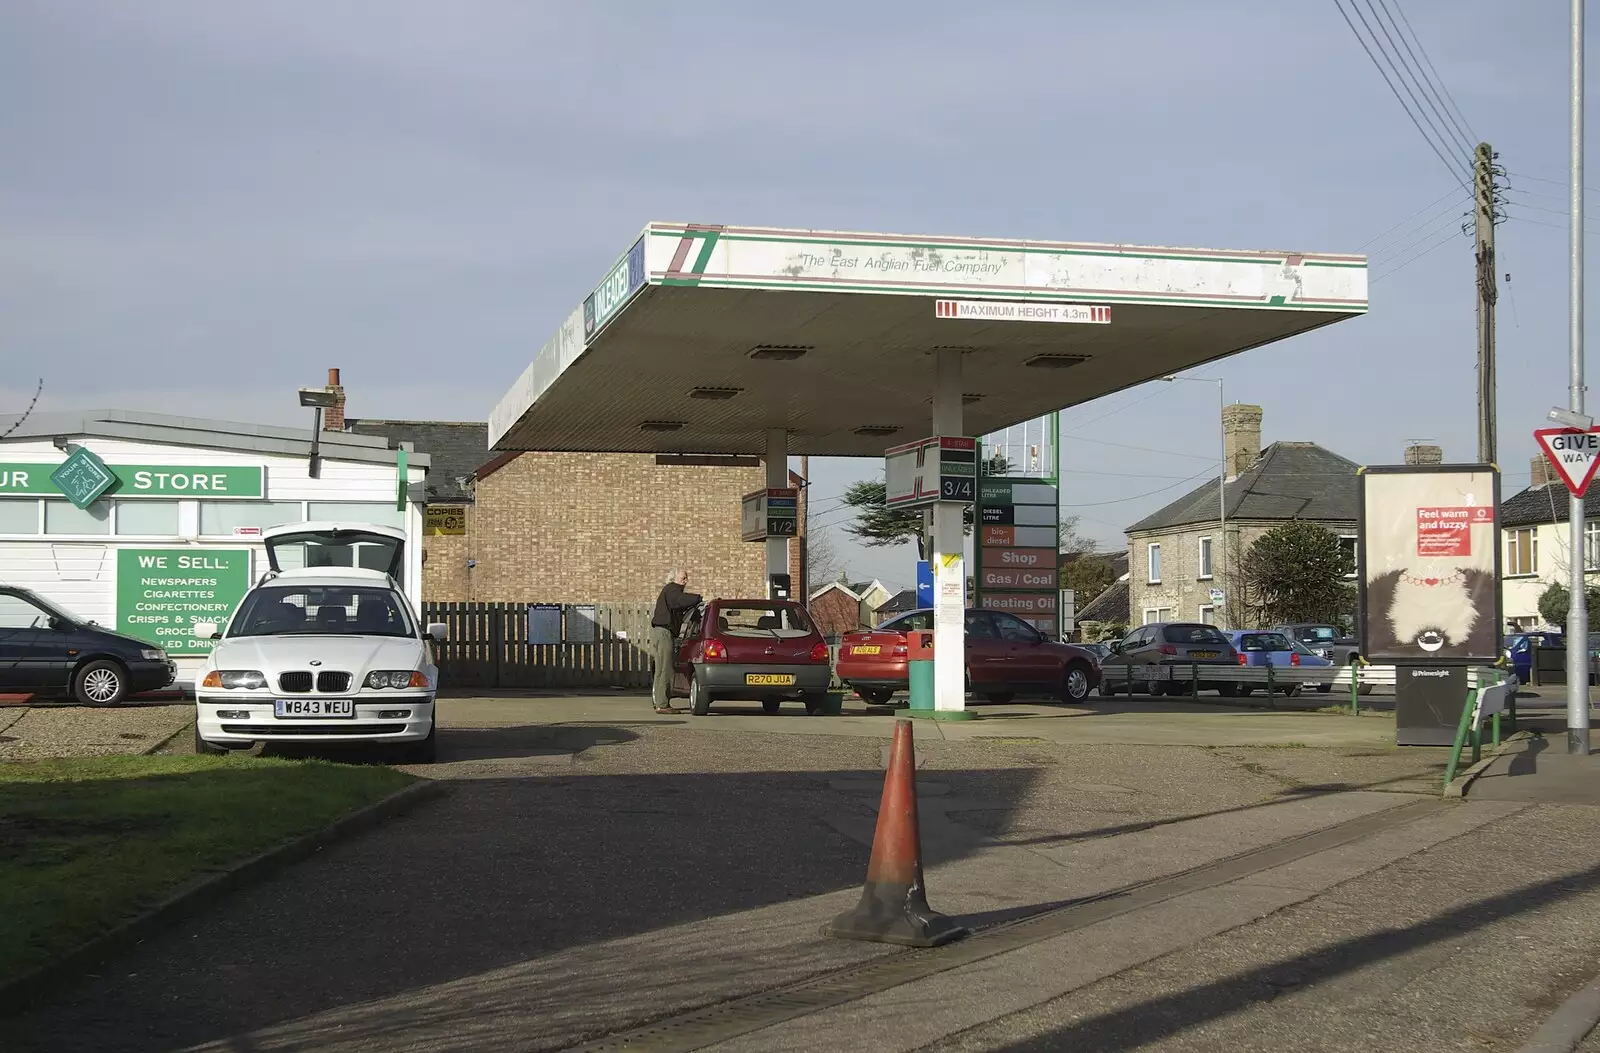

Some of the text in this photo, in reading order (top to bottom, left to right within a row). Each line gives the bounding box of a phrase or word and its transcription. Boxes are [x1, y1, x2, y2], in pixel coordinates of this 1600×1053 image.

[802, 254, 1002, 274] The East Anglian Fuel Company
[595, 261, 629, 324] UNLEADED
[960, 304, 1089, 320] MAXIMUM HEIGHT 4.3m
[1552, 435, 1598, 450] GIVE
[1563, 453, 1592, 463] WAY
[60, 459, 103, 481] YOUR STORE
[134, 471, 228, 491] STORE
[944, 481, 972, 497] 3/4
[426, 508, 464, 516] COPIES
[1419, 509, 1469, 518] Feel warm
[771, 521, 793, 533] 1/2
[1419, 520, 1469, 530] and fuzzy.
[991, 527, 1008, 535] bio-
[986, 536, 1010, 545] diesel
[138, 555, 229, 569] WE SELL:
[1002, 552, 1037, 565] Shop
[141, 578, 217, 586] NEWSPAPERS
[986, 573, 1052, 585] Gas / Coal
[143, 590, 215, 599] CIGARETTES
[135, 602, 229, 611] CONFECTIONERY
[982, 597, 1056, 610] Heating Oil
[127, 615, 229, 624] CRISPS & SNACK
[155, 627, 195, 636] GROCE
[188, 640, 217, 648] DRIN
[1418, 670, 1450, 678] Primesight
[748, 675, 791, 684] R270 JUA
[285, 701, 351, 714] W843 WEU
